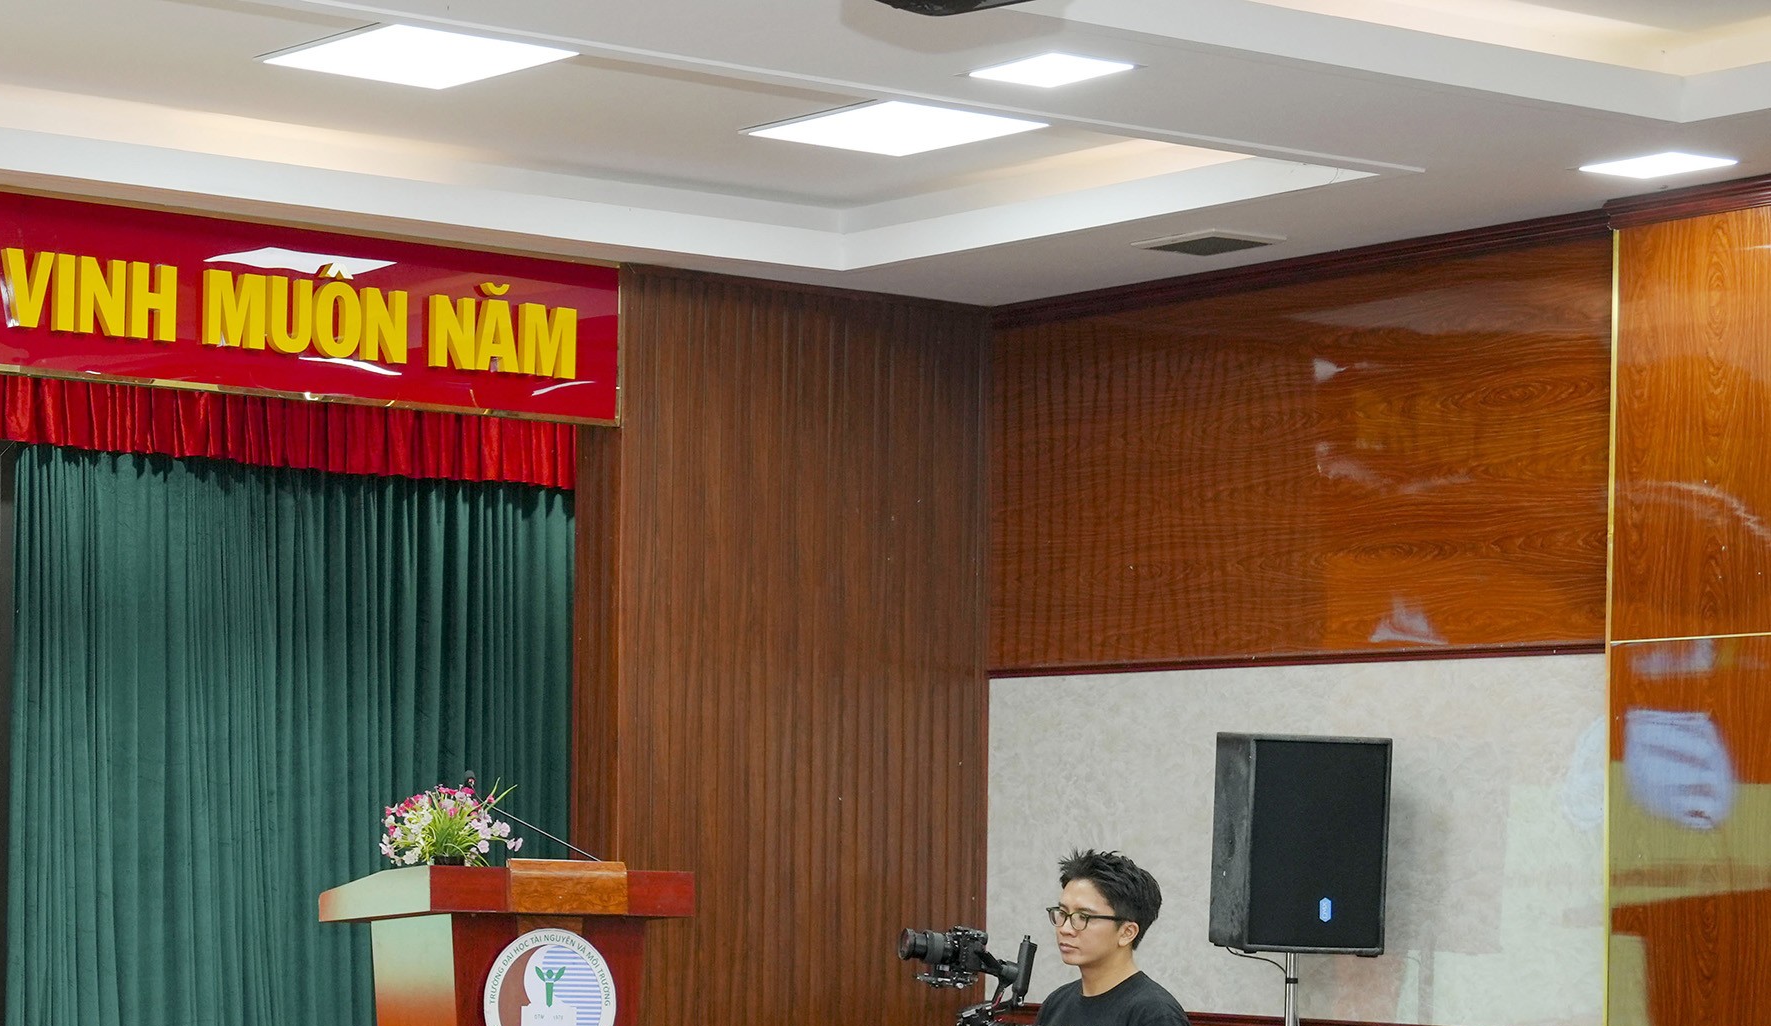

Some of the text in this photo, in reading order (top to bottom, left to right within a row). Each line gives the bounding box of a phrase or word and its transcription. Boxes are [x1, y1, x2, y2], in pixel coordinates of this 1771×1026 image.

[1, 248, 178, 342] VINH
[201, 262, 409, 364] MUÔN
[428, 282, 578, 380] NĂM
[530, 935, 543, 944] TÀI
[544, 934, 576, 947] NGUYÊN
